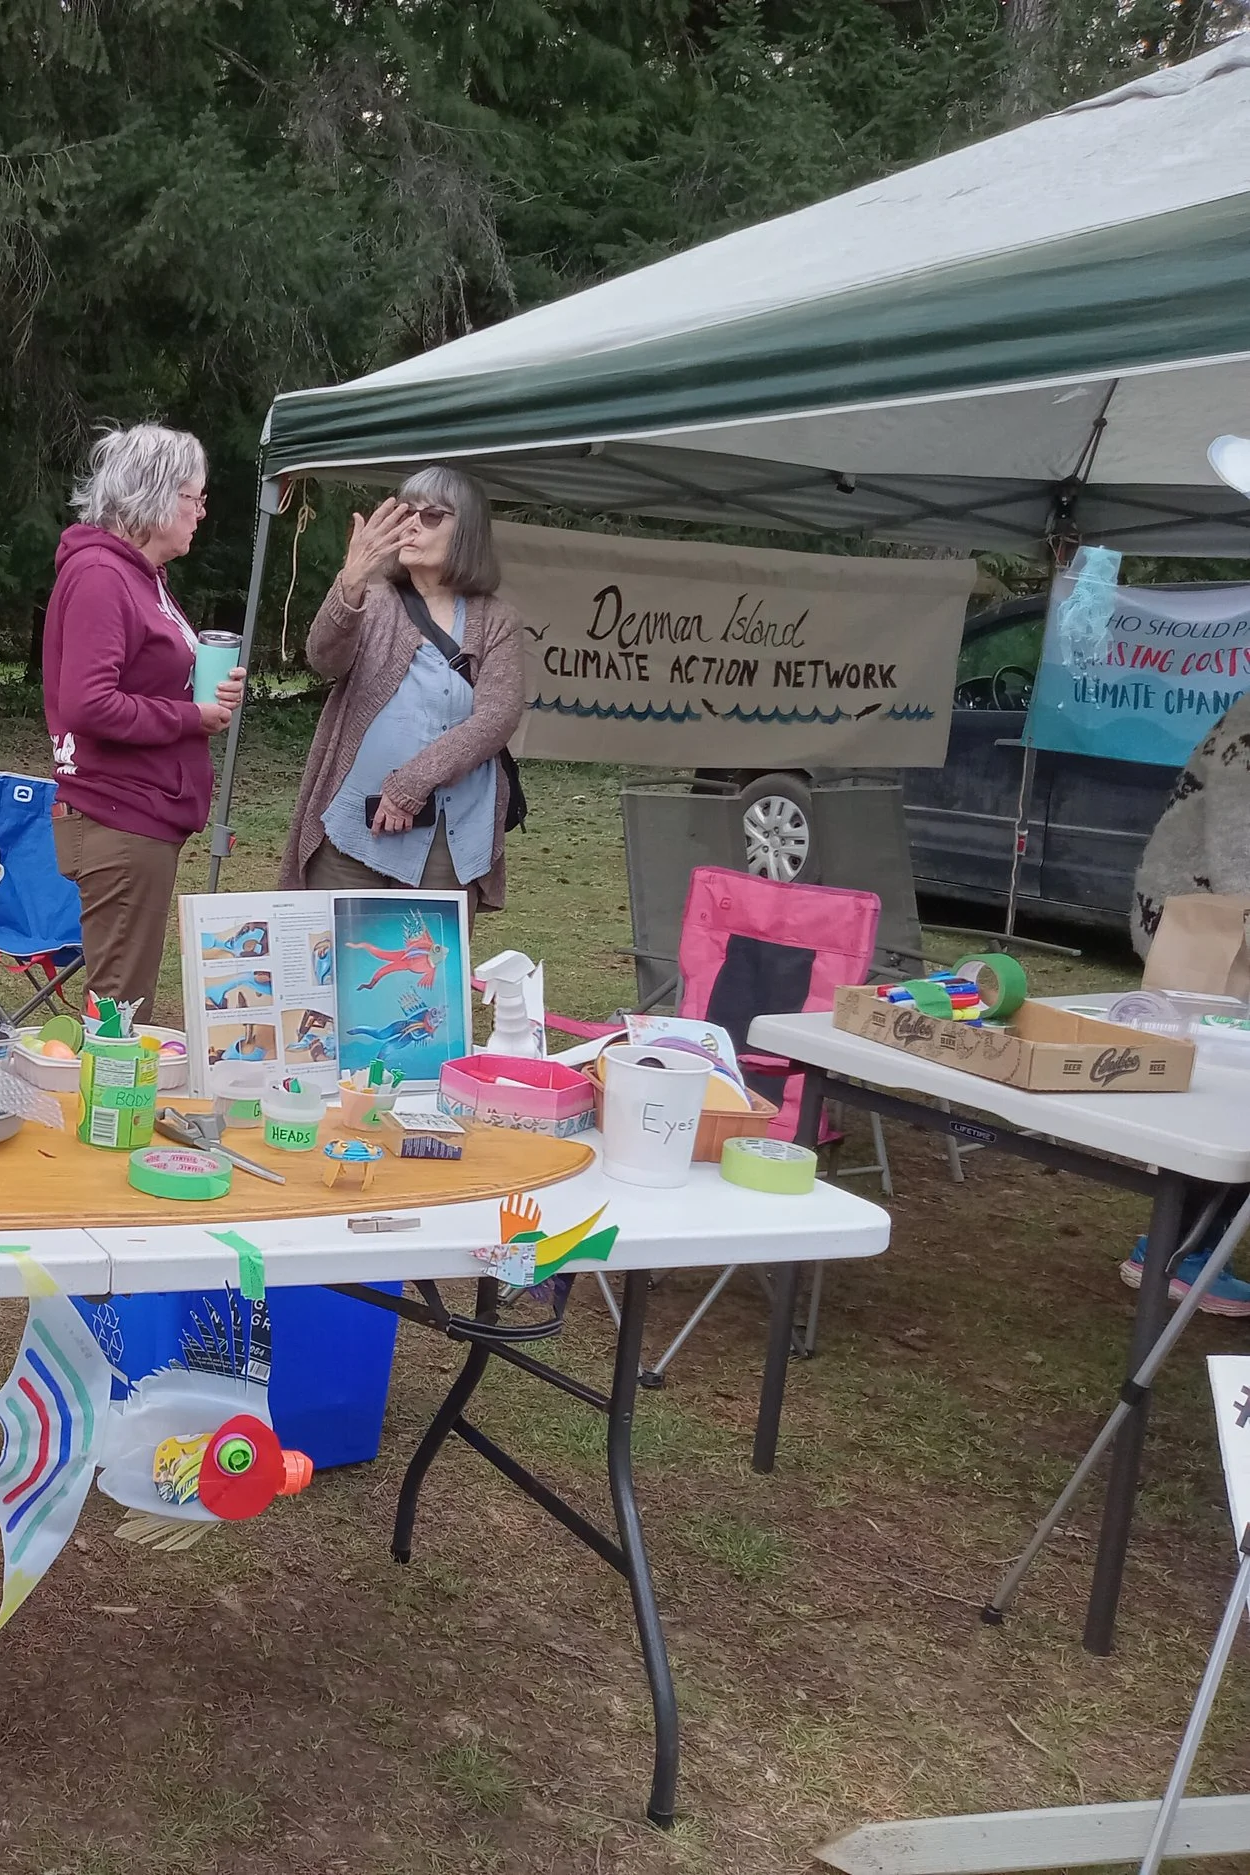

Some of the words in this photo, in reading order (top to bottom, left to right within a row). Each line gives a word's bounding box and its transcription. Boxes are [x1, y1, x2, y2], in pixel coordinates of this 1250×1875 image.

[586, 585, 712, 649] Denman
[720, 592, 810, 649] Island
[1105, 614, 1142, 632] HO
[1145, 618, 1231, 639] SHOULD
[543, 646, 650, 682] CLIMATE
[670, 655, 759, 686] ACTION
[773, 659, 899, 689] NETWORK
[1106, 640, 1175, 673] ISING
[115, 1091, 152, 1107] BODY
[272, 1126, 311, 1144] HEADS
[643, 1103, 695, 1144] Eyes
[954, 1124, 991, 1140] LIFETIME
